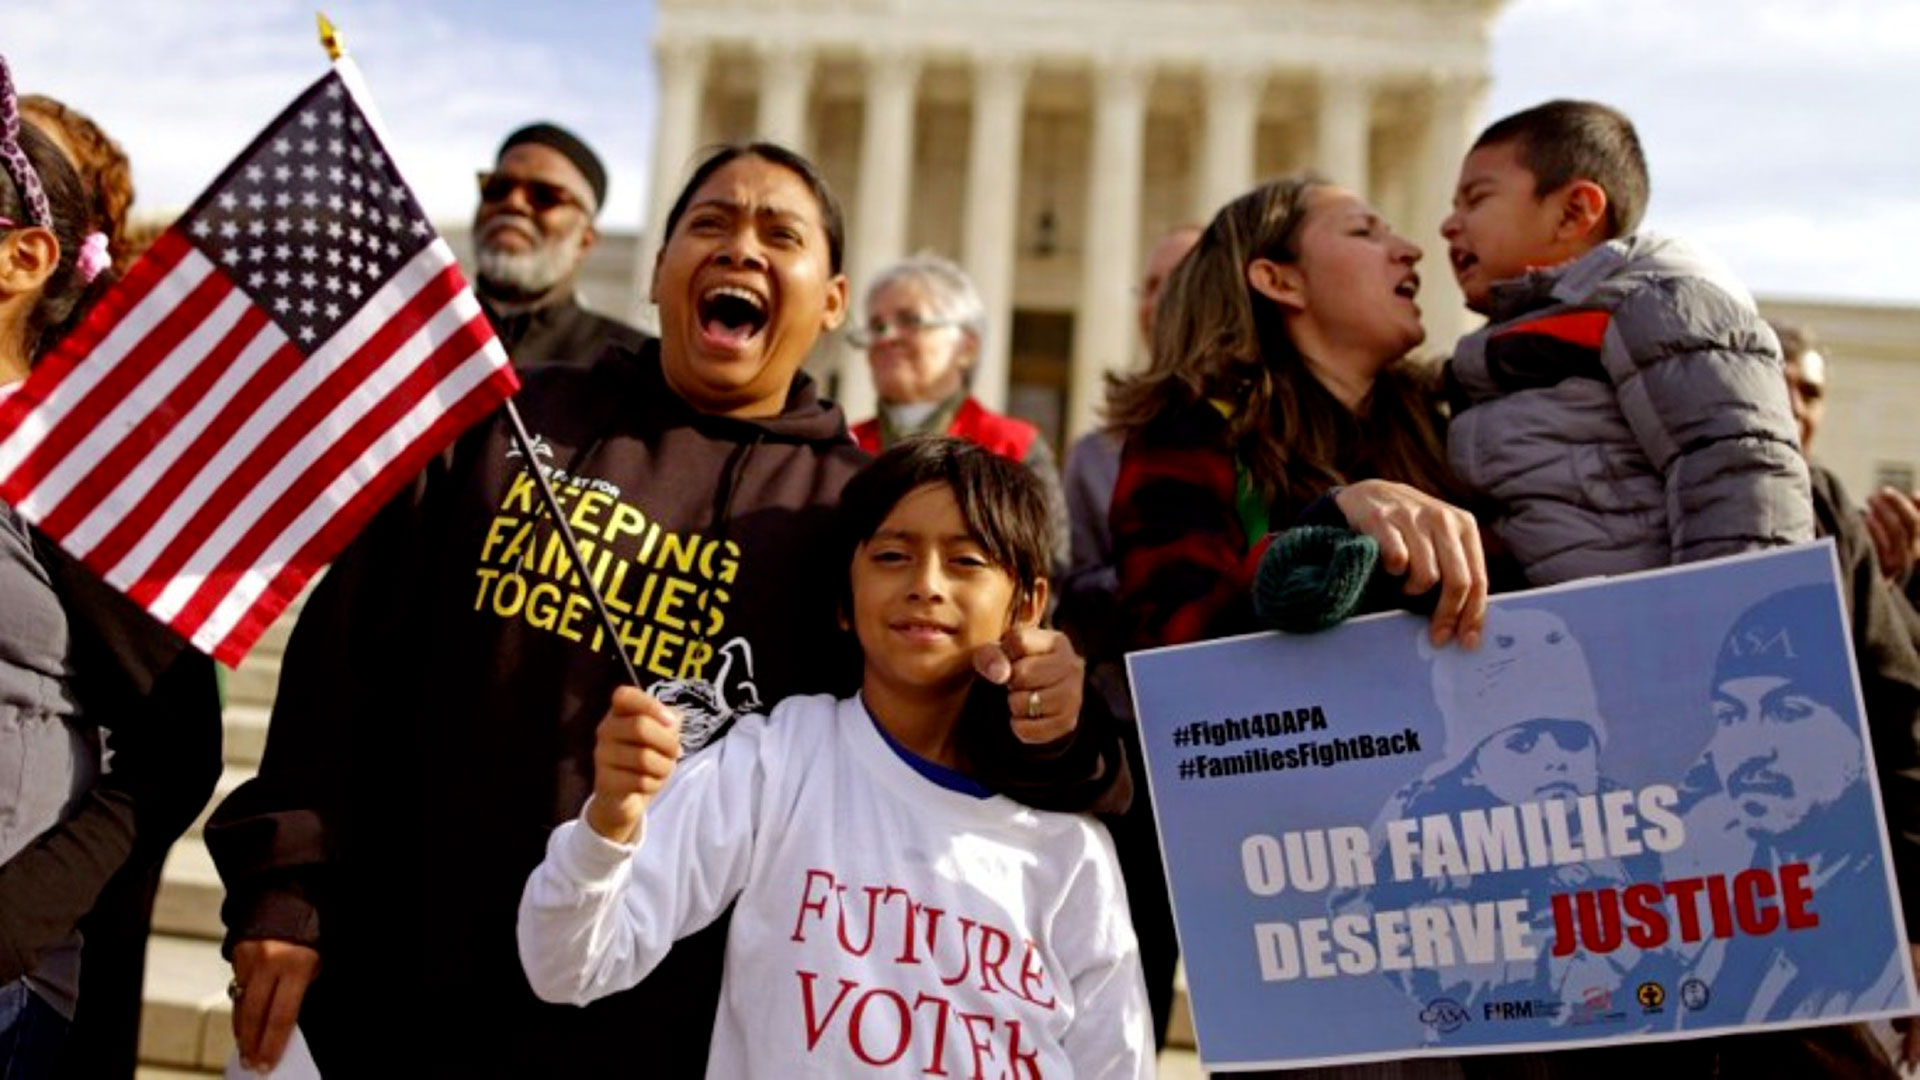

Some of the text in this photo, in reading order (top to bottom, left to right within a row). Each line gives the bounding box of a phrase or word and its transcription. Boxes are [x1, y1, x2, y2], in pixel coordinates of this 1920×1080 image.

[590, 478, 620, 498] FOR
[474, 567, 713, 681] TOGETHER
[481, 517, 730, 636] FAMILIES
[1173, 706, 1327, 748] #Fight4DAPA
[1179, 728, 1421, 781] #FamiliesFightBack
[1241, 785, 1685, 896] OUR FAMILIES
[790, 869, 1055, 1011] FUTURE
[1254, 863, 1819, 981] DESERVE JUSTICE
[1483, 1001, 1533, 1021] FIRM
